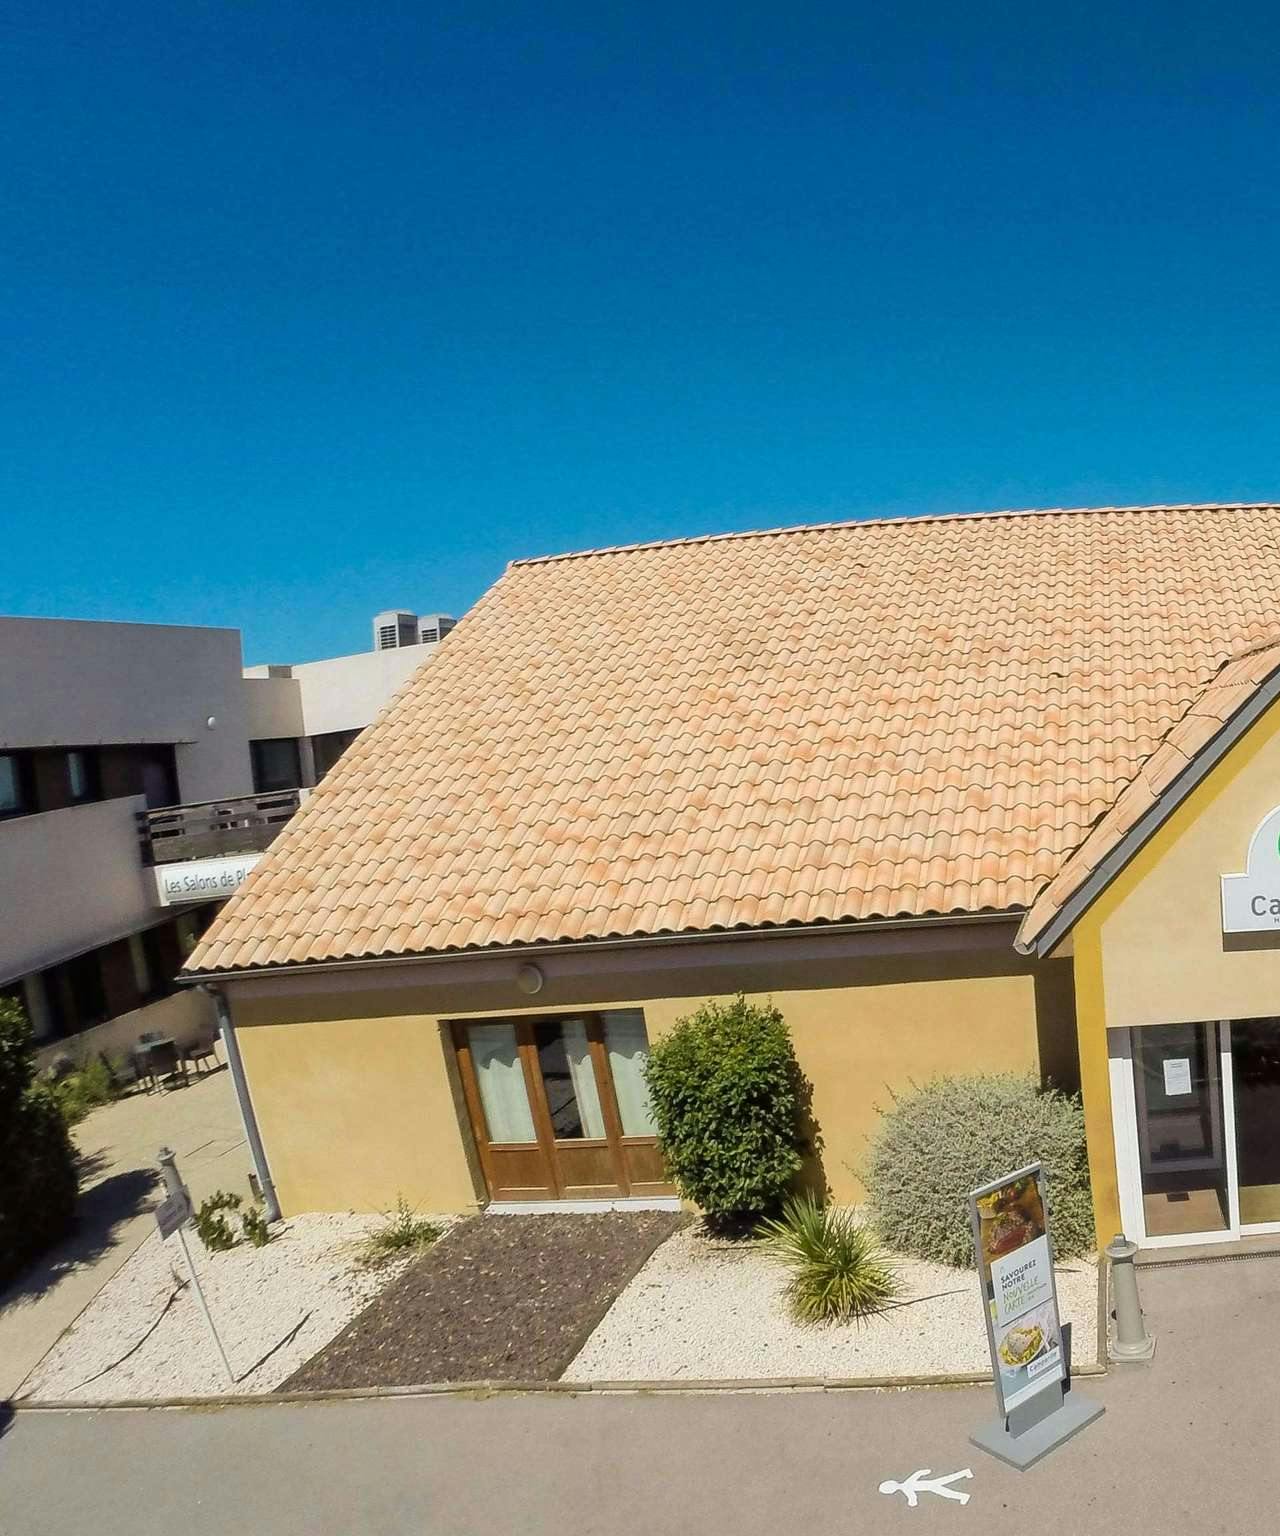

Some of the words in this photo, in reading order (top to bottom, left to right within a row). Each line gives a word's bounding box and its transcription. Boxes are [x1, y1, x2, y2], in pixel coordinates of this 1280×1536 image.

[165, 879, 181, 894] Les
[183, 874, 218, 892] Salons
[220, 871, 235, 887] de
[1001, 1259, 1037, 1284] SAVOUREZ
[1001, 1273, 1025, 1291] NOTRE
